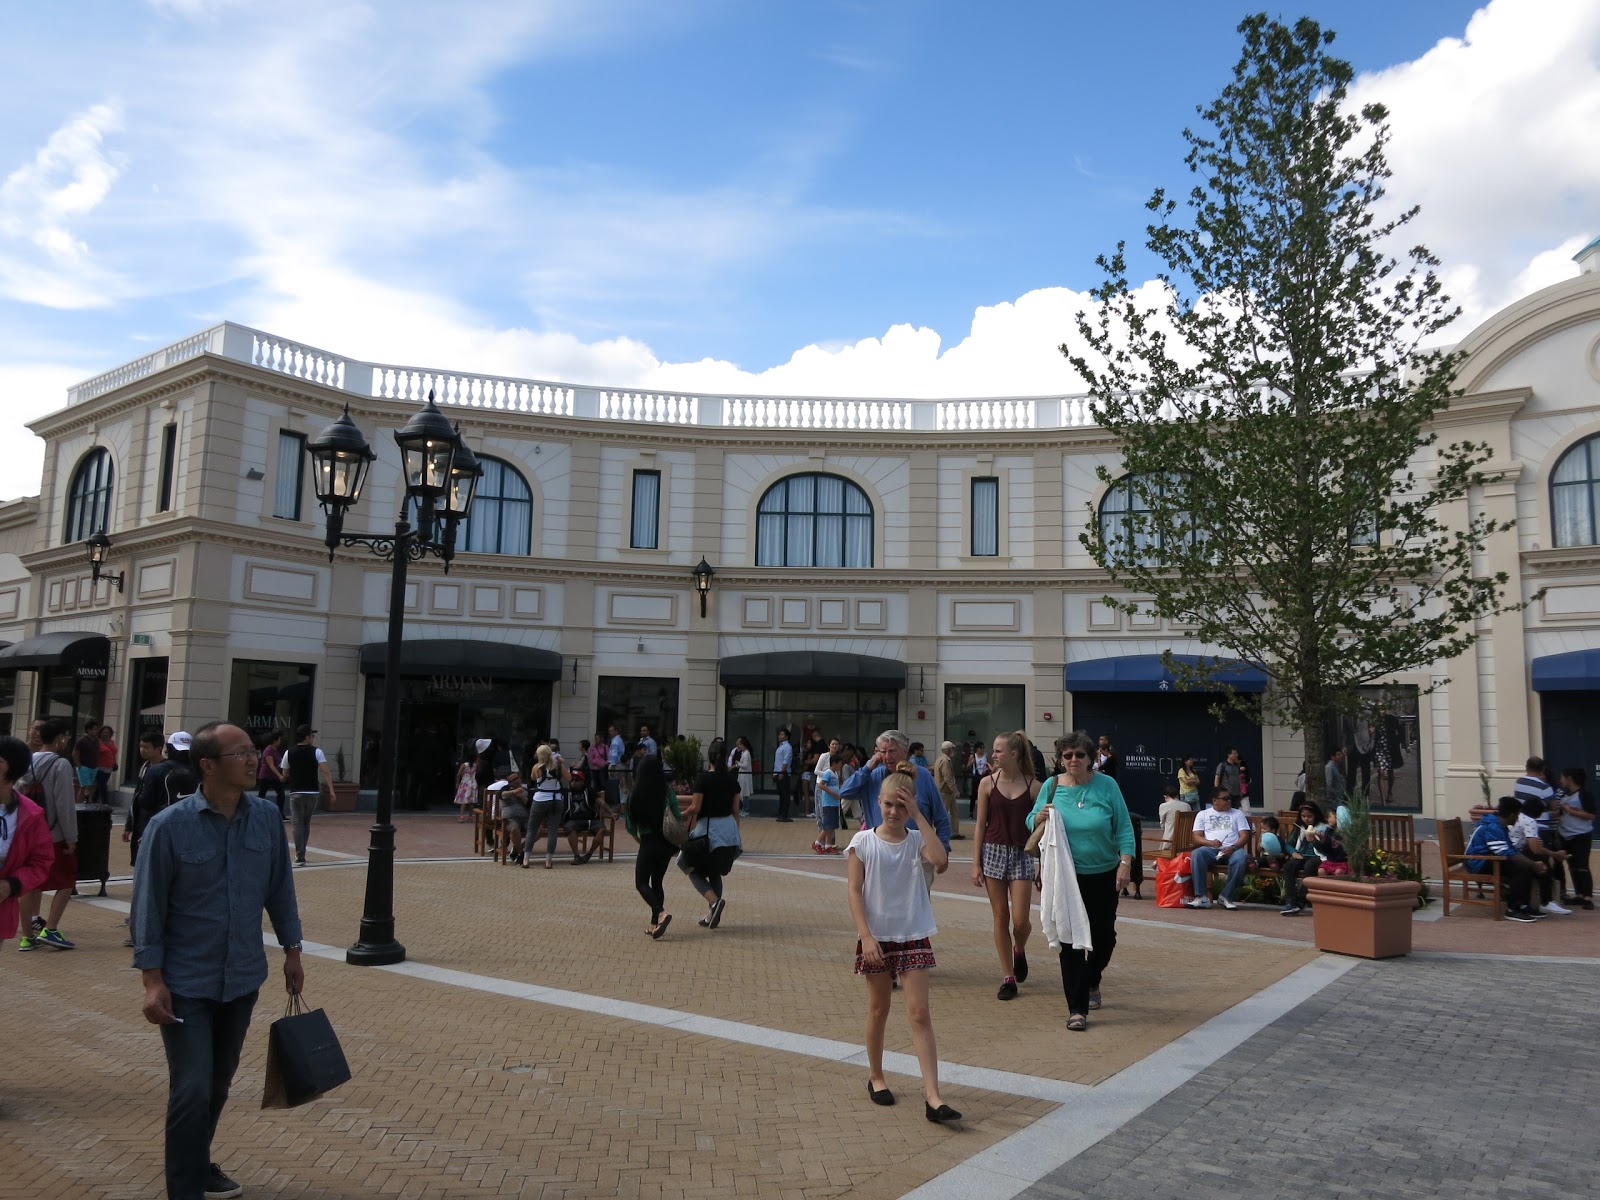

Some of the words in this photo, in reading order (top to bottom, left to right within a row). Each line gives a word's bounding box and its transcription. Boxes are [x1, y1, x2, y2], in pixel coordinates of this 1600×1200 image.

[76, 667, 106, 676] ARMANI
[428, 674, 494, 690] ARMANI
[244, 715, 291, 728] ARMANI
